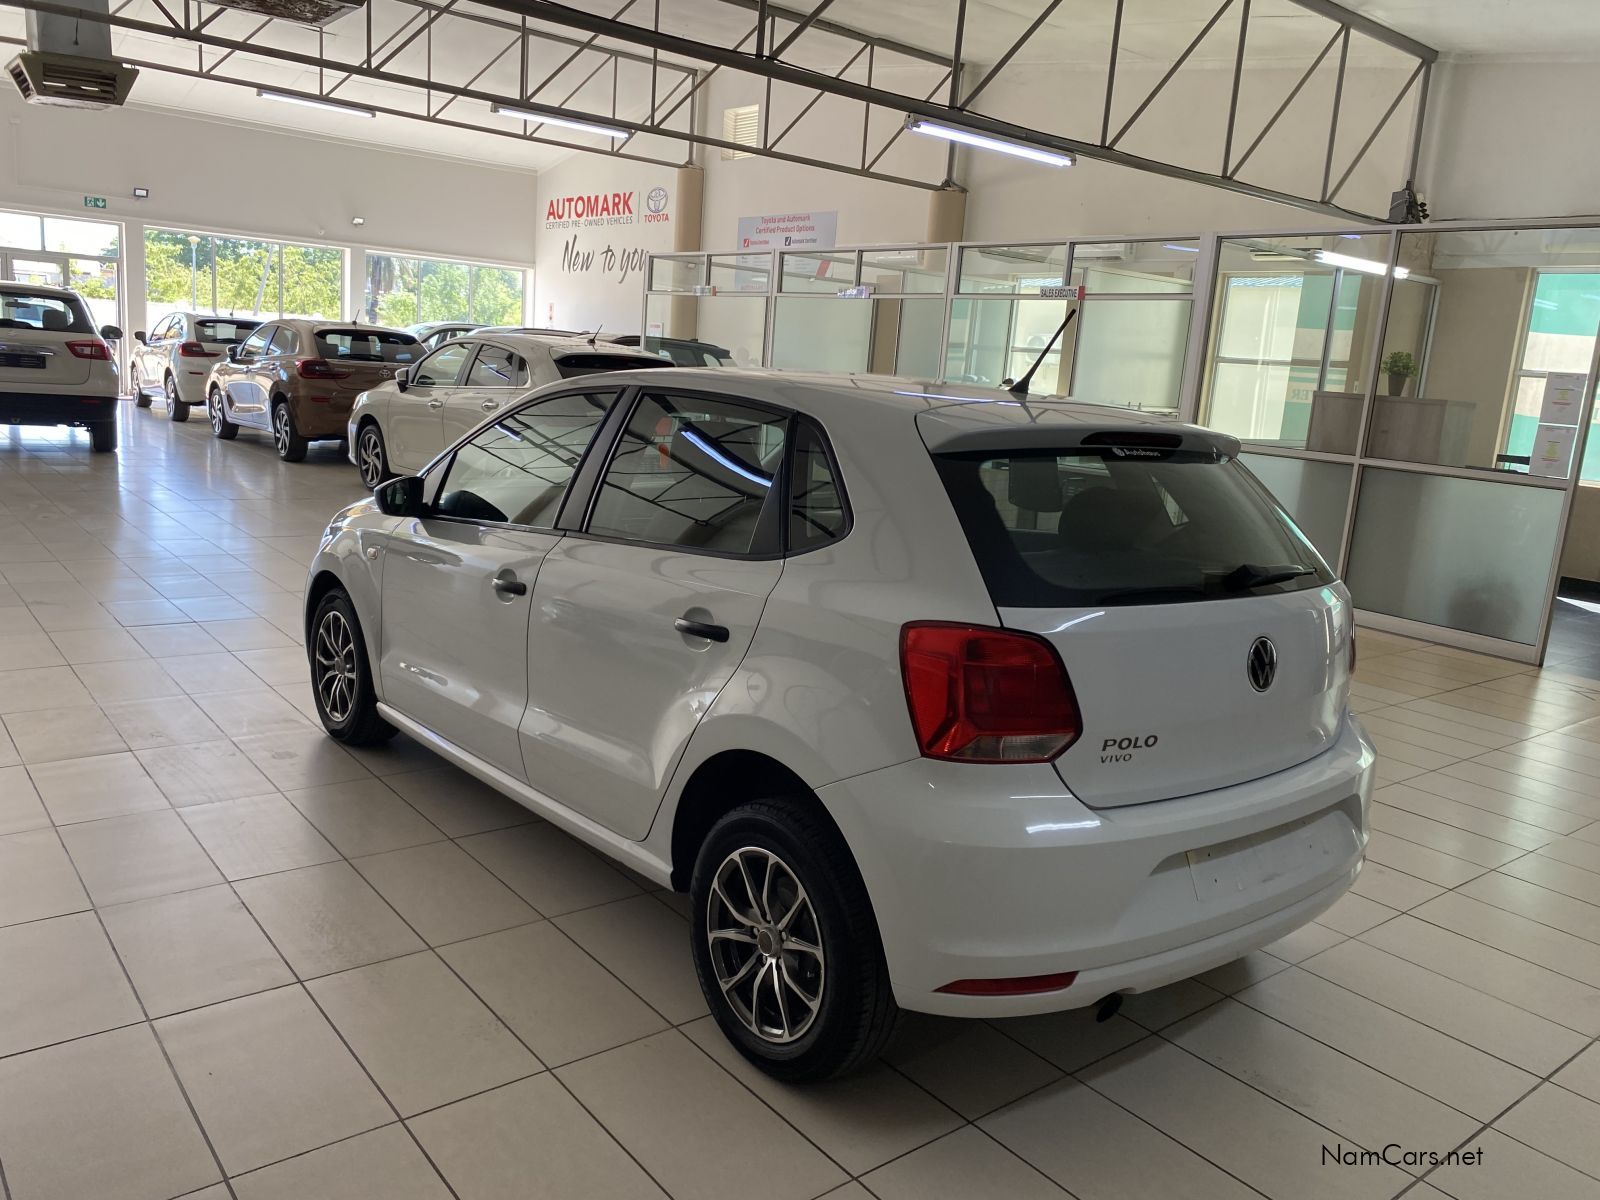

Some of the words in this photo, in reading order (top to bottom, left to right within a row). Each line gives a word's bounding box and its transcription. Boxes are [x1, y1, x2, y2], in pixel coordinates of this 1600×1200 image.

[546, 191, 634, 221] AUTOMARK
[545, 221, 570, 230] CERTIFIED
[606, 215, 633, 226] VEHICLES
[644, 213, 670, 223] TOYOTA
[761, 216, 776, 225] Toyota
[776, 215, 786, 223] and
[786, 214, 810, 222] Automark
[755, 226, 776, 234] Certified
[776, 225, 796, 233] Product
[795, 224, 815, 233] Options
[562, 233, 595, 275] New
[600, 244, 616, 274] to
[1040, 288, 1055, 298] SALES
[1055, 288, 1078, 298] EXECUTIVE
[1101, 734, 1159, 752] POLO
[1100, 753, 1132, 764] VIVO
